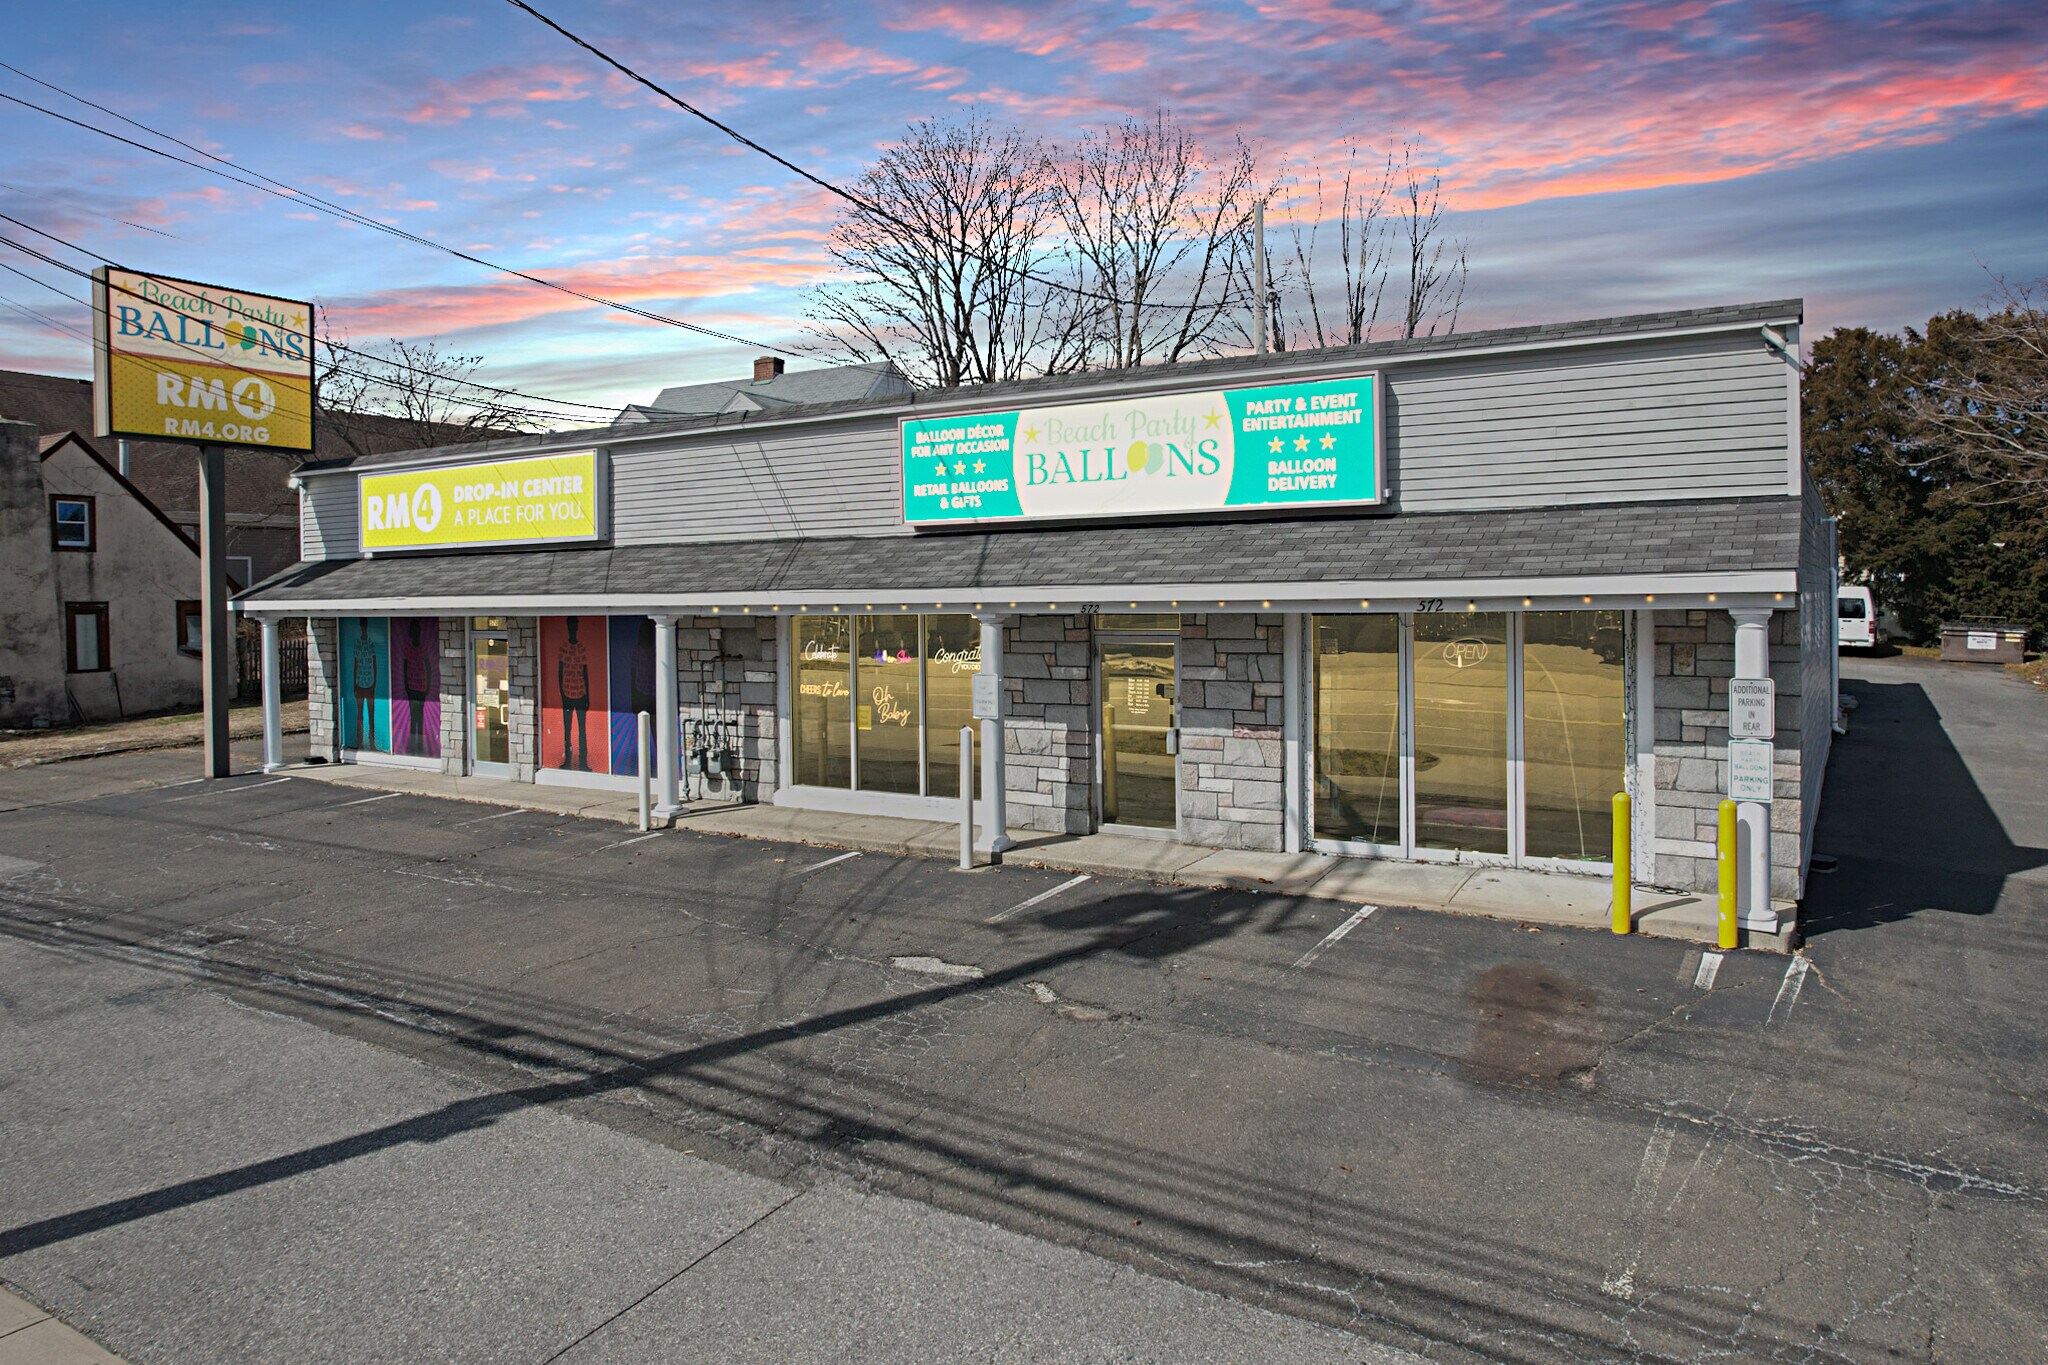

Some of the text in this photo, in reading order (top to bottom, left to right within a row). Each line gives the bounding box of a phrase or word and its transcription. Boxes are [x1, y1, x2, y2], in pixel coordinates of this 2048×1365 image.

[138, 280, 288, 338] Beach Party
[157, 373, 276, 420] RM4
[1246, 392, 1358, 416] PARTY & EVENT
[165, 417, 270, 443] RM4.ORG
[1044, 407, 1197, 450] Beach Party
[1242, 408, 1362, 432] ENTERTAINMENT
[916, 423, 1004, 444] BALLOON DÉCOR
[911, 438, 1010, 458] FOR ANY OCCASION
[1267, 457, 1337, 475] BALLOON
[453, 475, 584, 503] DROP-IN CENTER
[914, 479, 1009, 497] RETAIL BALLOONS
[1267, 473, 1338, 492] DELIVERY
[367, 483, 443, 533] RM4
[940, 495, 982, 510] & GIFTS
[454, 501, 585, 527] A PLACE FOR YOU.
[1080, 604, 1100, 614] 572
[934, 643, 982, 674] Congrat
[1444, 643, 1486, 661] OPEN
[872, 685, 895, 706] Oh
[1733, 686, 1771, 695] ADDITIONAL
[1737, 698, 1766, 707] PARKING
[877, 701, 912, 727] Baby
[1747, 710, 1756, 719] IN
[1742, 721, 1761, 731] REAR
[1733, 774, 1769, 784] PARKING
